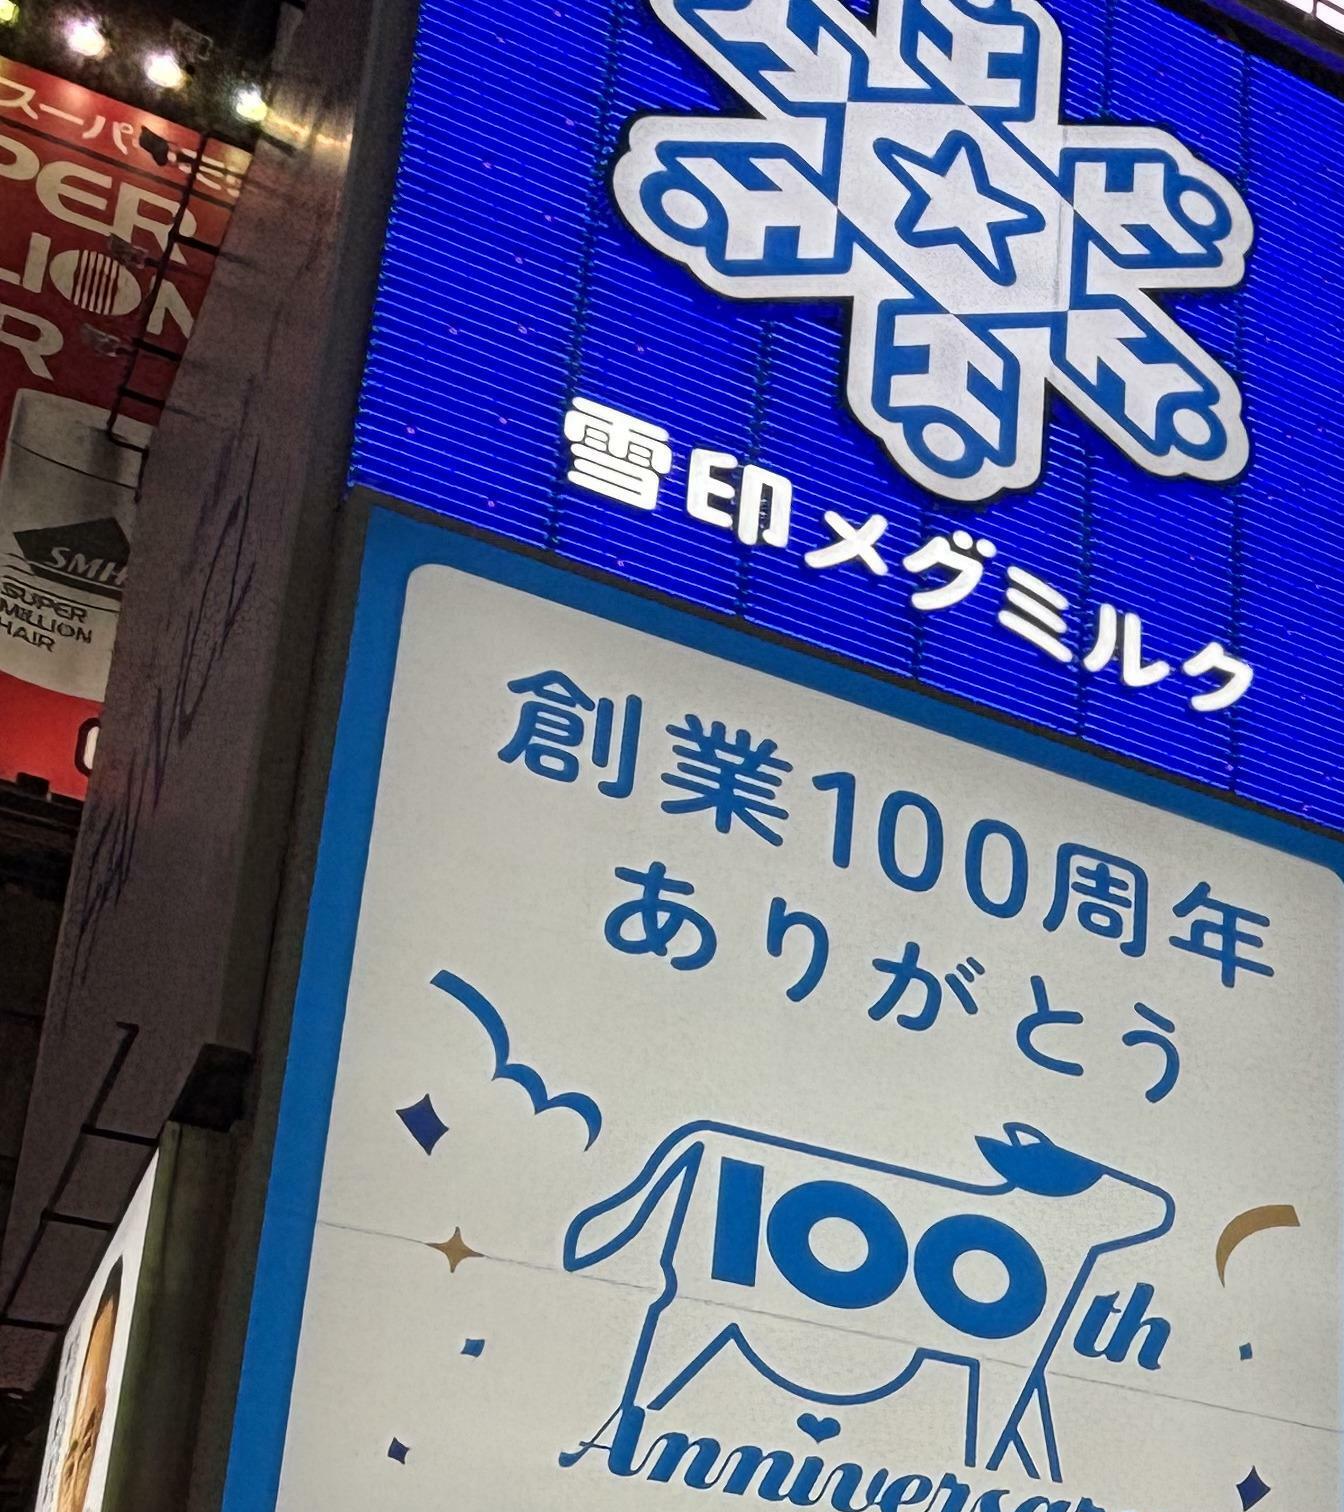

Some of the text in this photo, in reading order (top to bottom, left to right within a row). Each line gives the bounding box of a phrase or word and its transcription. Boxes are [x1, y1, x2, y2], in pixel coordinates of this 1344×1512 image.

[0, 603, 93, 644] MILLION
[1, 582, 88, 624] SUPER
[563, 396, 1255, 713] 雪印メグミルク
[497, 669, 1275, 988] 創業100周年
[605, 862, 1181, 1102] ありがとう
